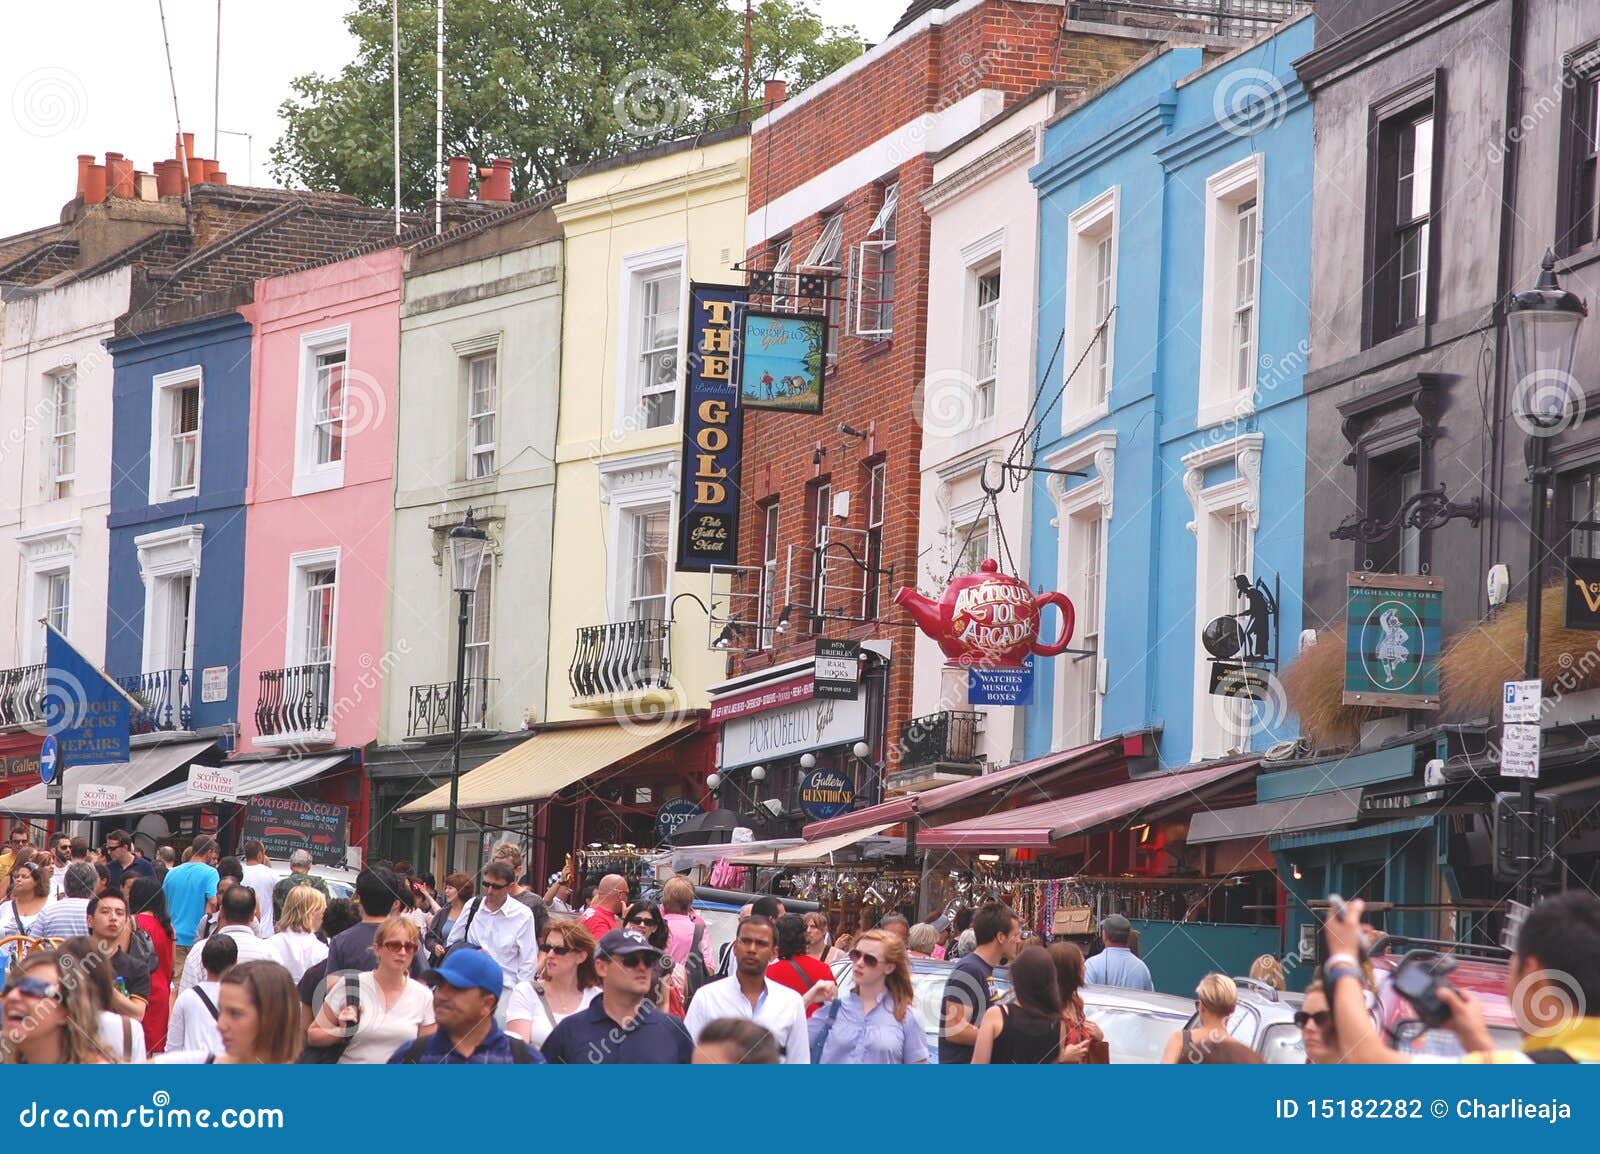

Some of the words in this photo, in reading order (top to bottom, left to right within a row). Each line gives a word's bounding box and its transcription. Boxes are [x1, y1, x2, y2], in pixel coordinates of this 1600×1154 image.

[747, 325, 804, 340] PORTOBELLO
[700, 301, 733, 379] THE
[695, 383, 737, 395] Portobello
[693, 400, 730, 504] GOLD
[715, 529, 728, 539] &
[1353, 588, 1403, 597] HIGHLAND
[1407, 591, 1438, 599] STORE
[1589, 582, 1600, 593] G
[951, 582, 1034, 622] ANTIQUE
[958, 617, 1034, 646] ARCADE
[980, 675, 1023, 683] WATCHES
[981, 684, 1022, 693] MUSICAL
[987, 693, 1017, 701] BOXES
[749, 705, 811, 753] PORTOBELLO
[196, 772, 233, 785] SCOTTISH
[810, 772, 845, 793] Gallery
[192, 782, 234, 794] CASHMERE
[83, 790, 118, 801] SCOTTISH
[802, 789, 853, 804] GUESTHOUSE
[250, 796, 312, 812] PORTOBELLO
[313, 803, 341, 817] GOLD
